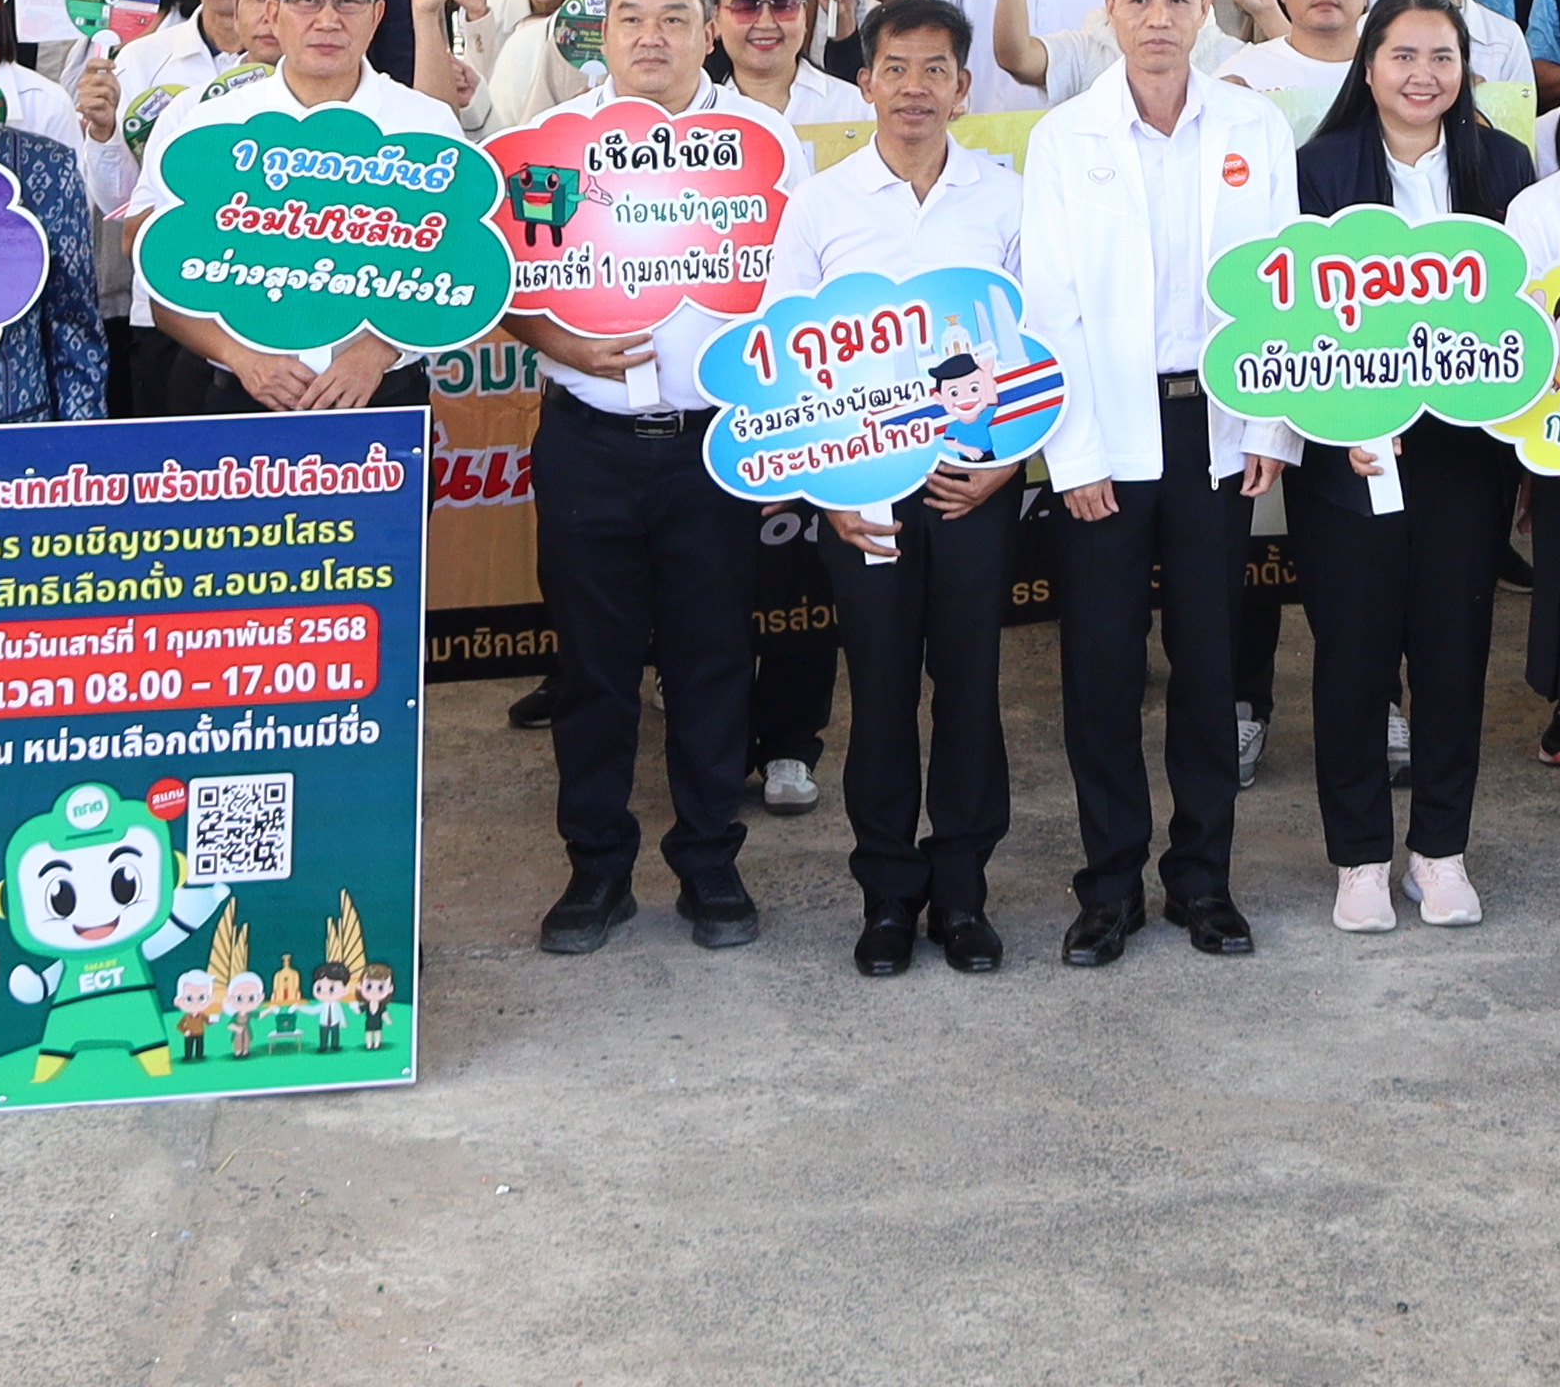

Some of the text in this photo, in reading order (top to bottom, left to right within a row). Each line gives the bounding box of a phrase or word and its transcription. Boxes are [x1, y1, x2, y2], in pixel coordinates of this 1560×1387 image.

[232, 140, 458, 194] 1 กุมภาพันธ์
[587, 127, 741, 175] เช็คให้ดี
[217, 194, 447, 250] ร่วมไปใช้สิทธิ
[614, 194, 767, 236] ก่อนเข้าคูหา
[180, 249, 476, 308] อย่างสุจริตโปร่งใส
[602, 254, 613, 283] 1
[622, 244, 731, 296] กุมภาพันธ์
[739, 249, 772, 281] 25
[1260, 253, 1483, 325] 1 กุมภา
[749, 304, 929, 390] 1 กุมภา
[1238, 327, 1523, 390] กลับบ้านมาใช้สิทธิ
[734, 377, 927, 439] ร่วมสร้างพัฒนา
[134, 444, 405, 506] พร้อมใจไปเลือกตั้ง
[739, 417, 932, 484] ประเทศไทย
[31, 517, 354, 561] ขอเชิญชวนชาวยโสธร
[193, 560, 394, 599] ส.อบจ.ยโสธร
[143, 628, 159, 654] 1
[165, 615, 293, 661] กุมภาพันธ์
[298, 615, 367, 644] 2568
[427, 626, 559, 663] มาชิกสภ
[751, 595, 838, 636] ารส่ว
[85, 670, 182, 705] 08.00
[219, 663, 318, 699] 17.00
[326, 662, 365, 693] น.
[22, 713, 380, 765] หน่วยเลือกตั้งที่ท่านมีชื่อ
[78, 966, 126, 994] ECT
[84, 959, 119, 971] SMART
